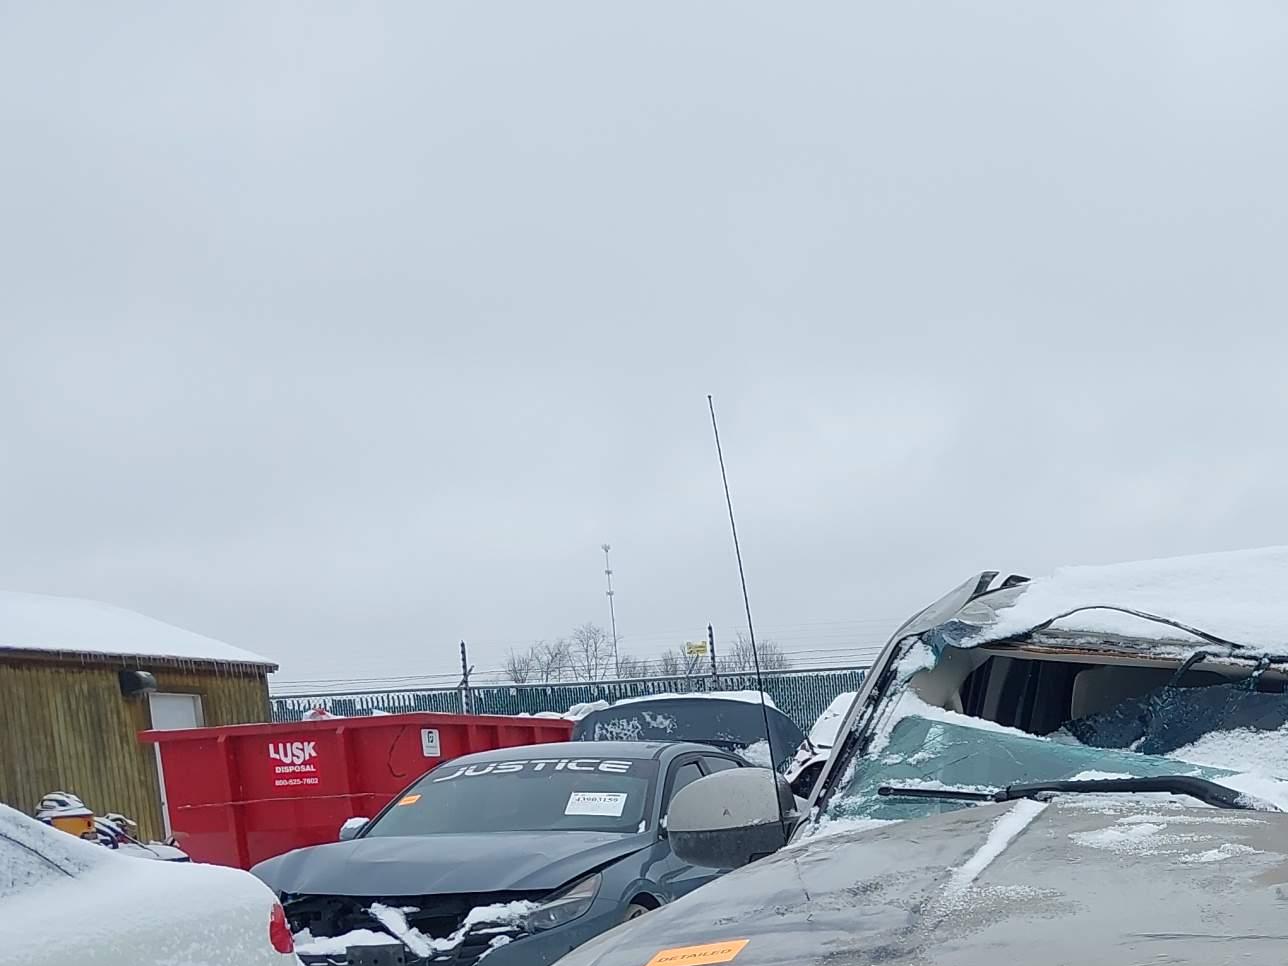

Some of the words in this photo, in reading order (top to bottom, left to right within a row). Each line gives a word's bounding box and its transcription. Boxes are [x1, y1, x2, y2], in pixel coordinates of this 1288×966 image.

[268, 741, 318, 765] LUSK
[275, 764, 317, 774] DISPOSAL
[432, 758, 633, 783] JUSTICE
[656, 948, 733, 963] DETAILED
